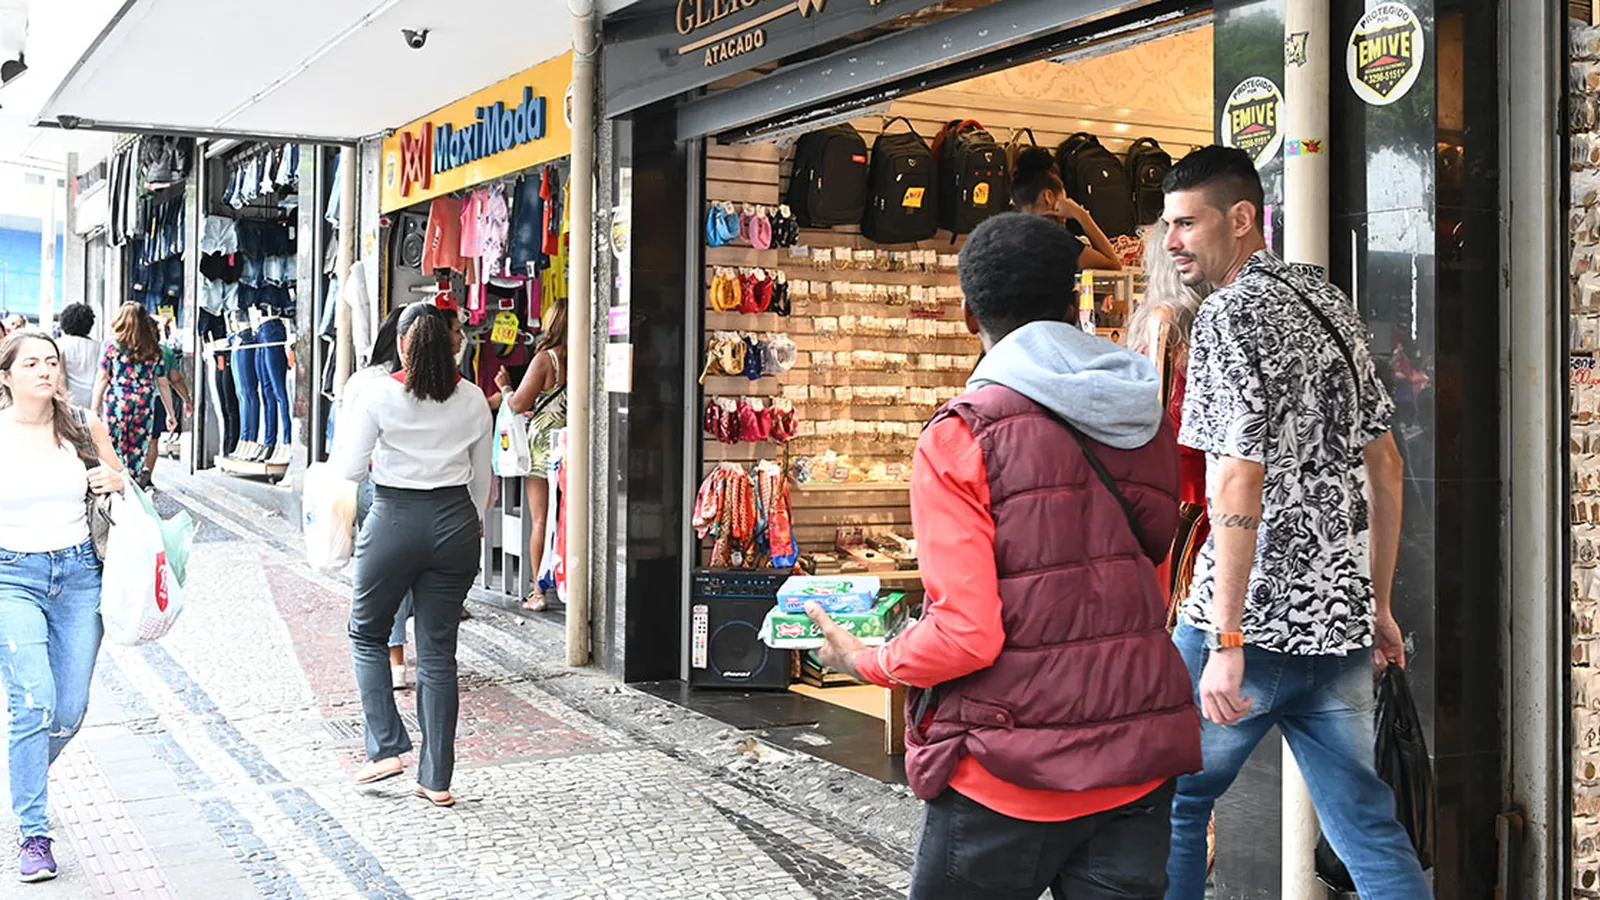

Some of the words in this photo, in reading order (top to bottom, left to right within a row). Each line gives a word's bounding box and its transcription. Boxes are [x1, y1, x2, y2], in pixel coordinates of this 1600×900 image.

[1360, 6, 1410, 29] PROTEGIDO
[704, 28, 766, 67] ATACADO
[1359, 31, 1411, 68] EMIVE
[1232, 79, 1273, 100] PROTEGIDO
[1232, 101, 1275, 134] EMIVE
